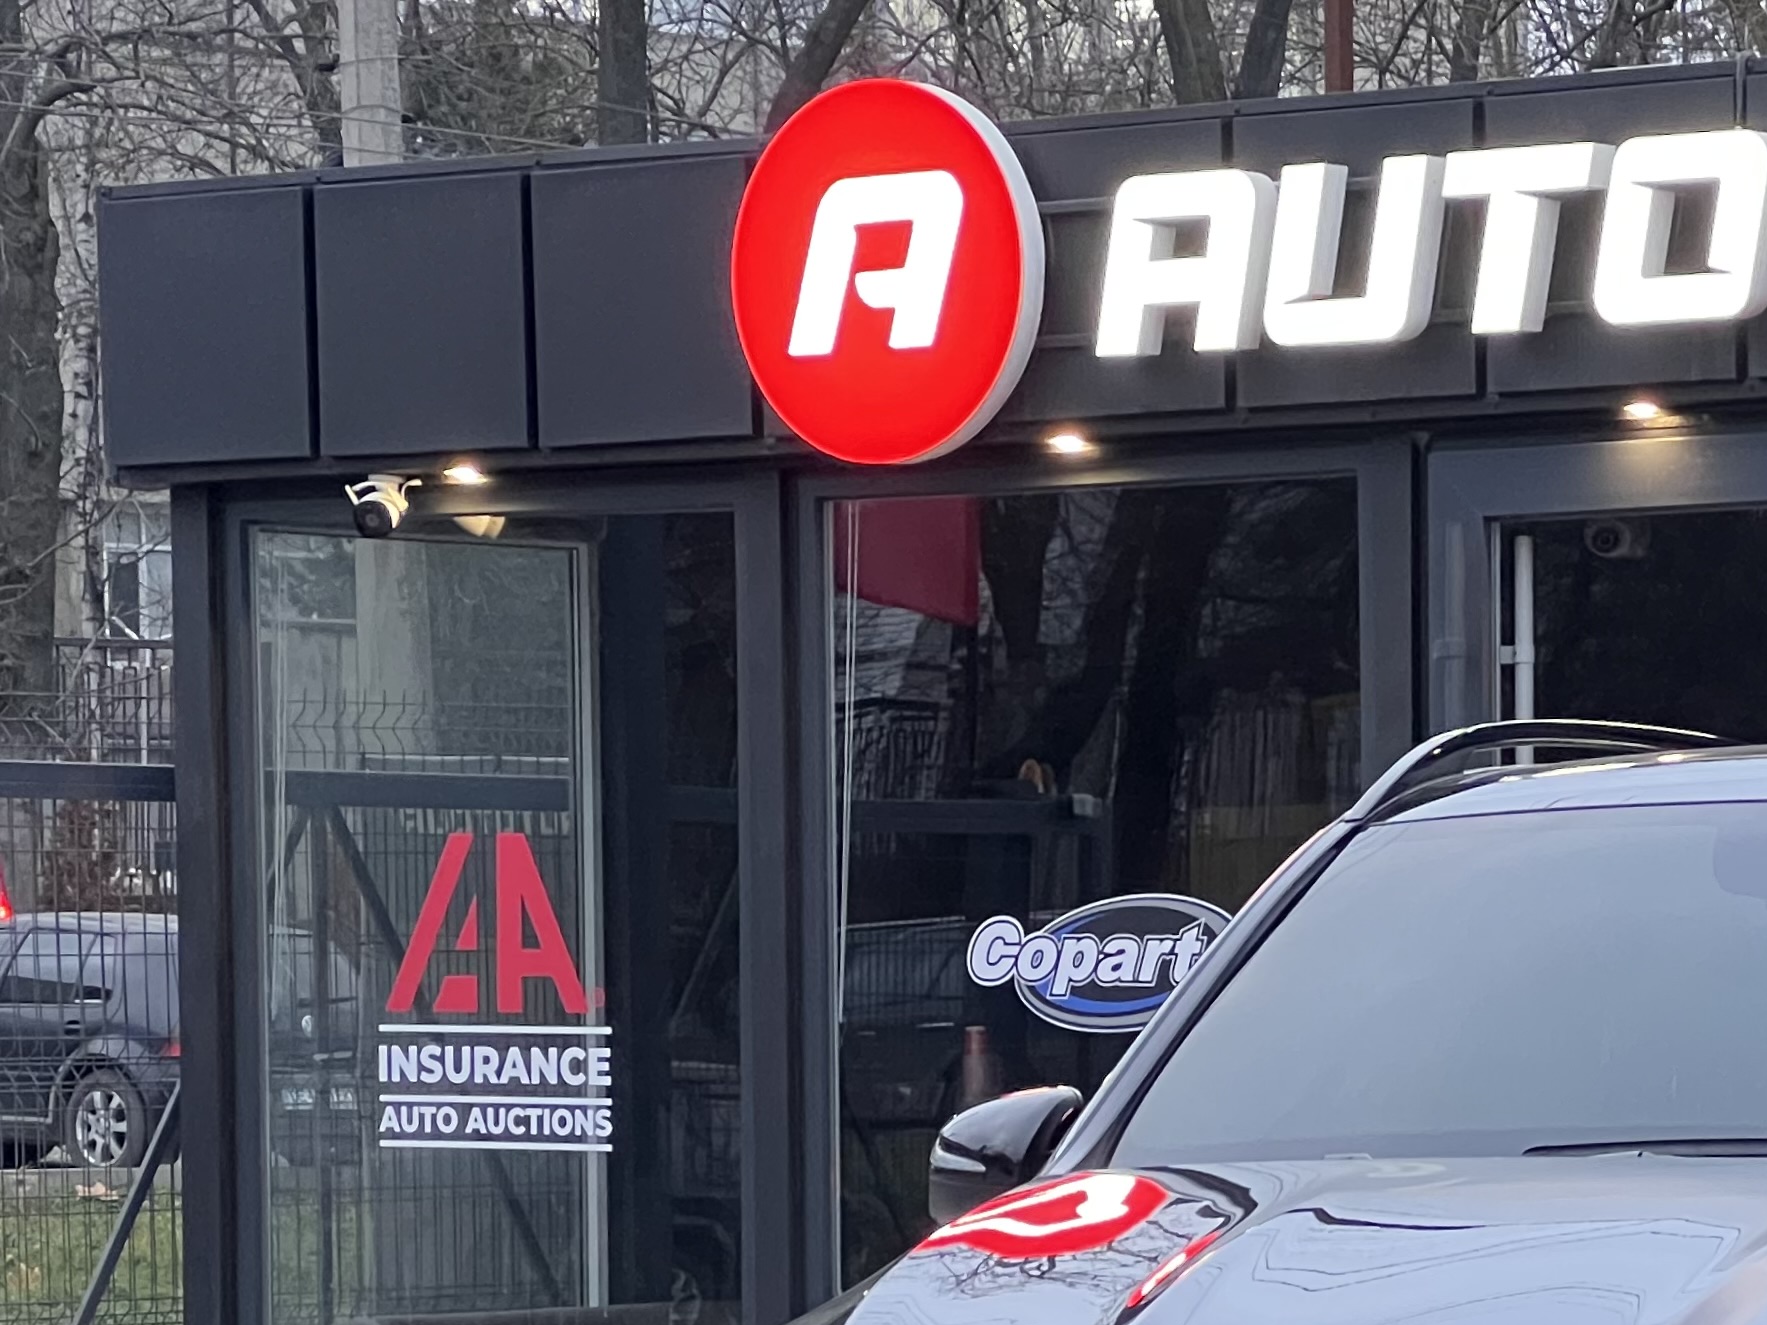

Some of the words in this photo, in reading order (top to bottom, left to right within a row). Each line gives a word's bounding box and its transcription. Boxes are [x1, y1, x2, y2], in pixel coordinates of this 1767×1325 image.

[967, 916, 1208, 1000] Copart
[378, 1044, 612, 1086] INSURANCE
[379, 1105, 458, 1135] AUTO
[465, 1105, 613, 1138] AUCTIONS
